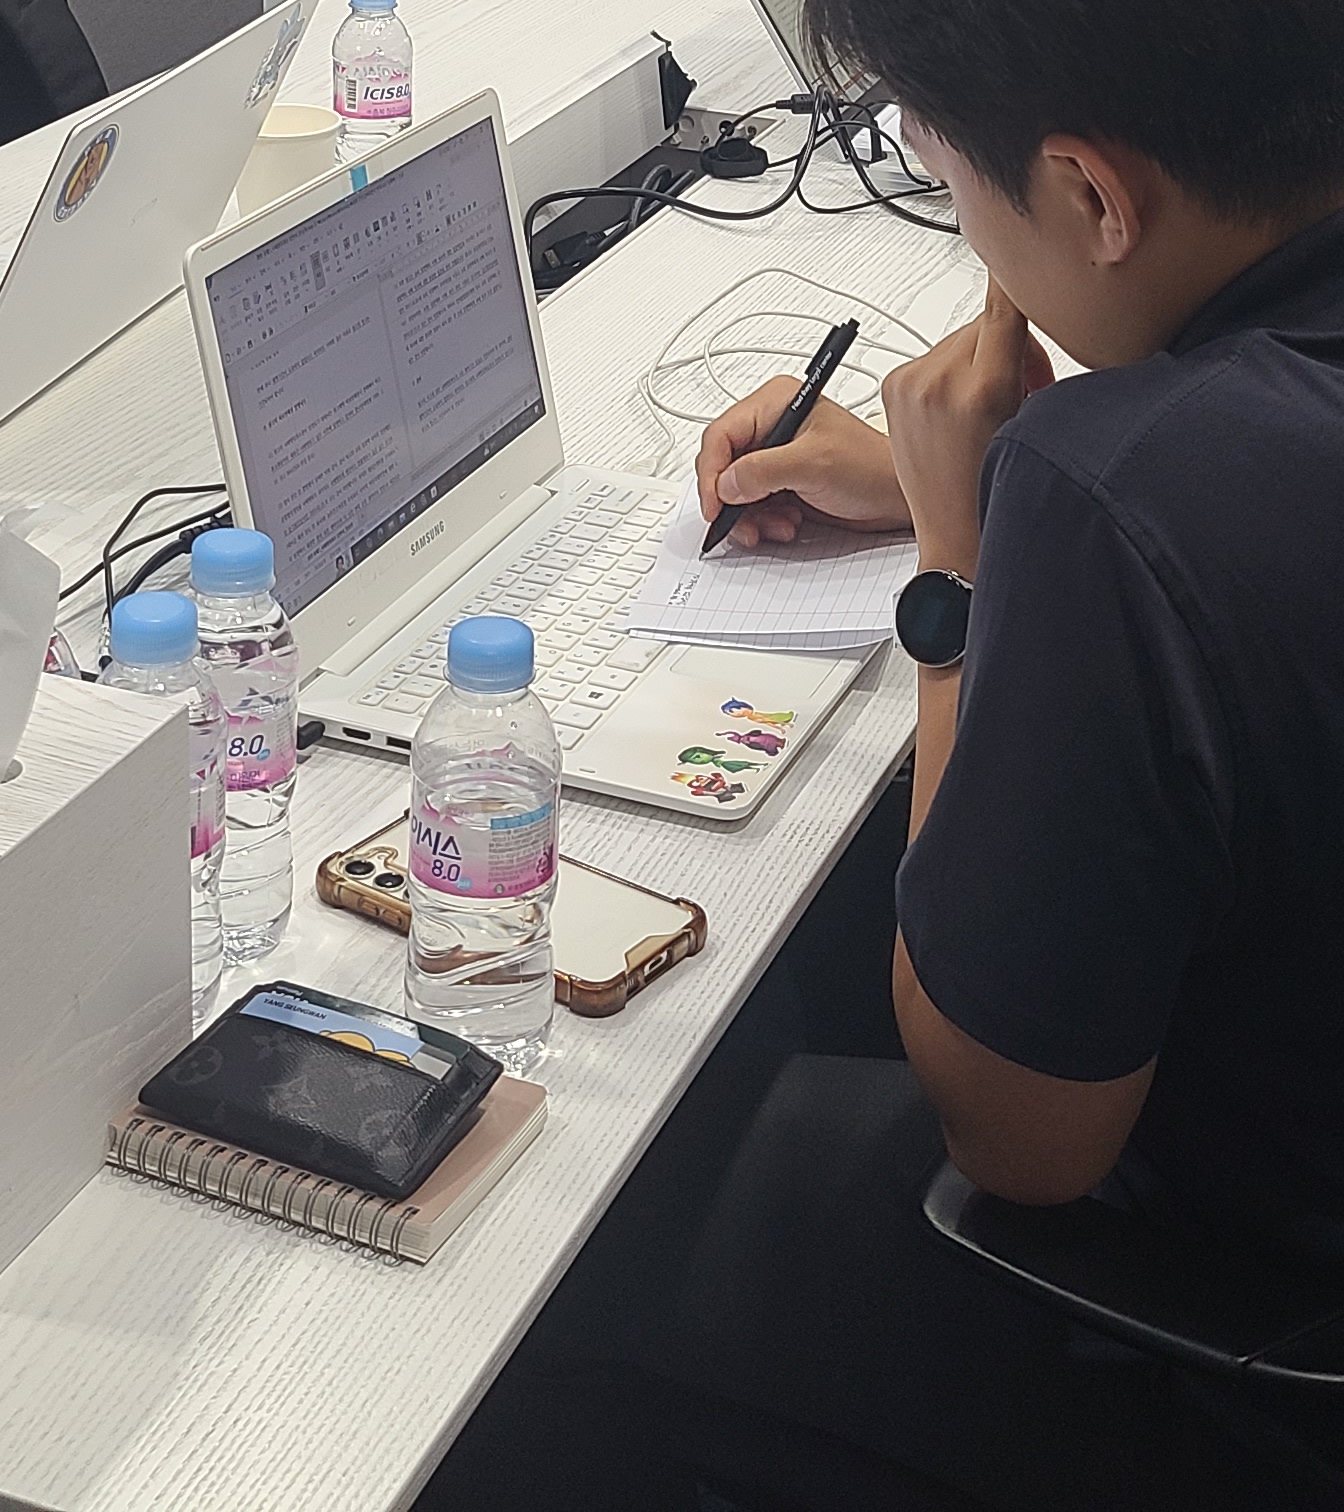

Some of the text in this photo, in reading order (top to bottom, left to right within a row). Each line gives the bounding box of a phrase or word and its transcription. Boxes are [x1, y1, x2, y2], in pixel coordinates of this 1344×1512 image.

[363, 86, 396, 100] ICIS
[410, 520, 445, 556] SAMSUNG
[228, 734, 264, 757] 8.0
[431, 859, 461, 882] 8.0
[263, 998, 285, 1008] YANG
